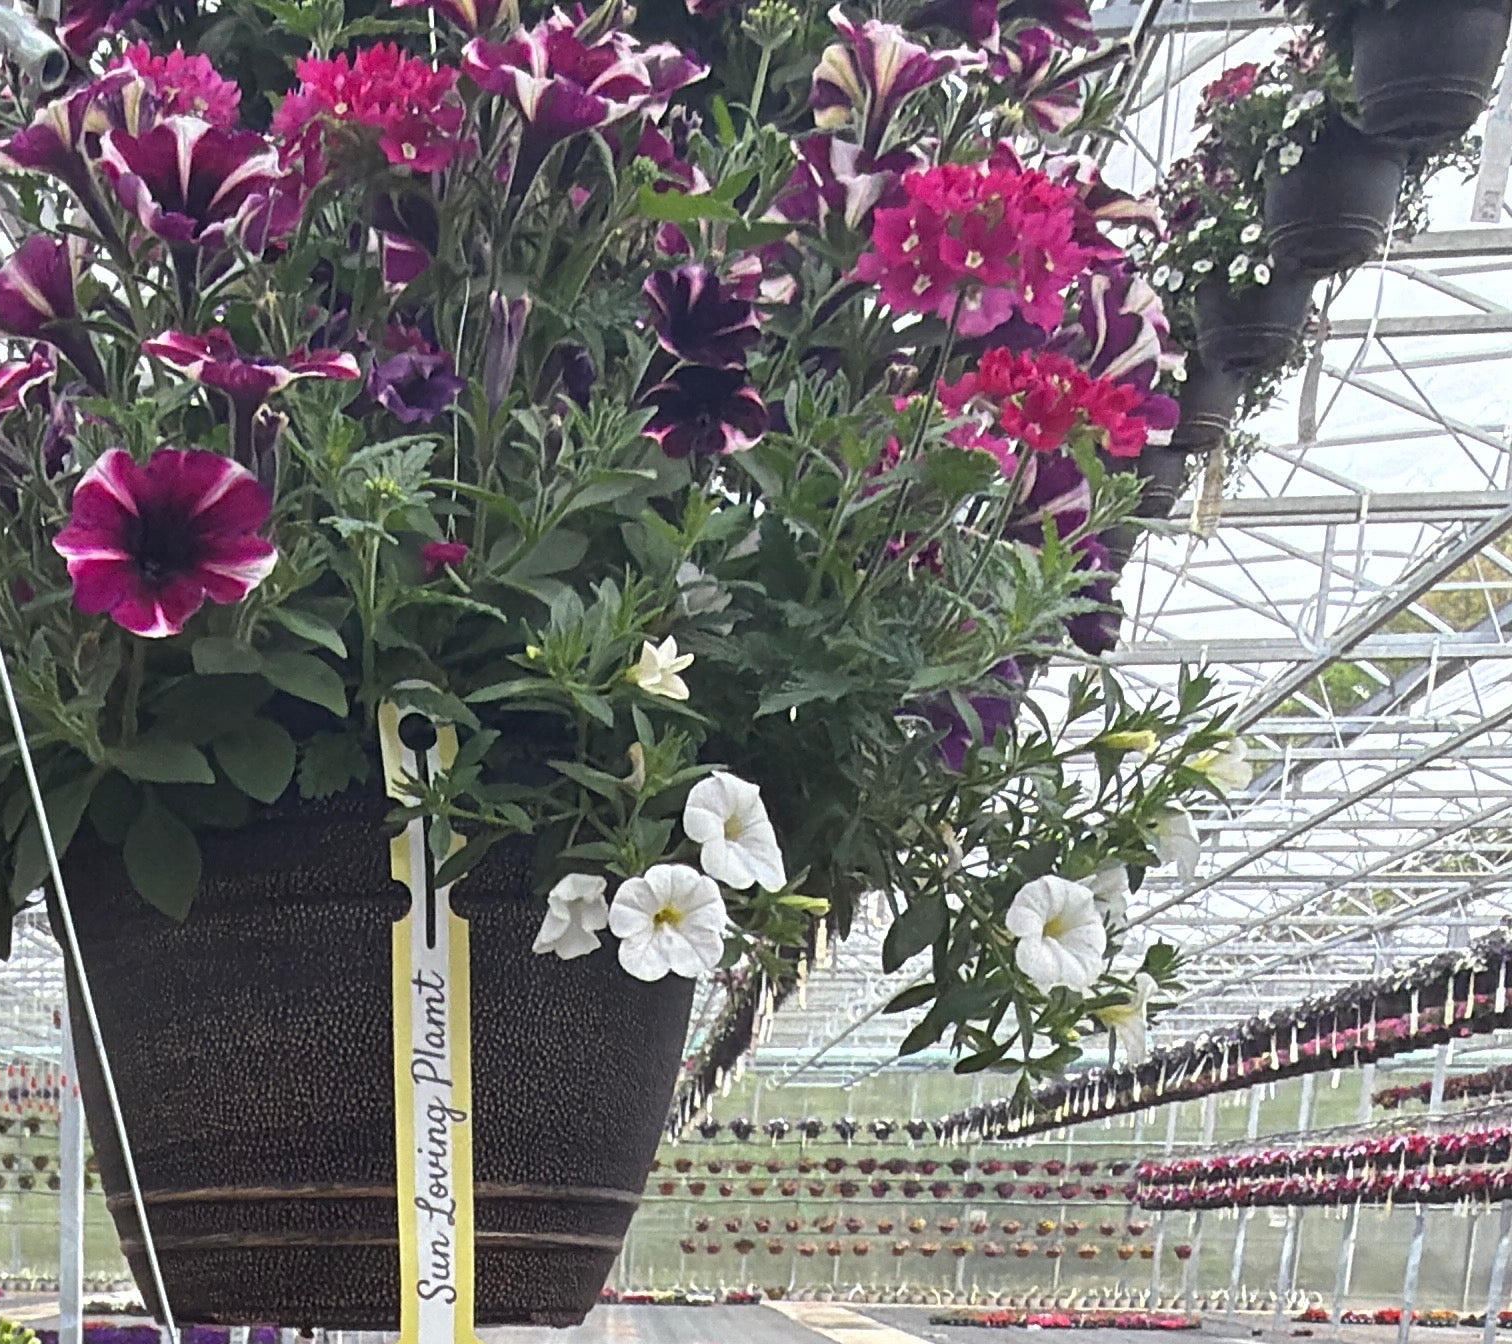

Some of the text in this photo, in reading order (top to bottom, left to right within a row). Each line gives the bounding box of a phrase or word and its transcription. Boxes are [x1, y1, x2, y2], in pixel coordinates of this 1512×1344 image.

[411, 969, 467, 1305] Sun Loving Plant
